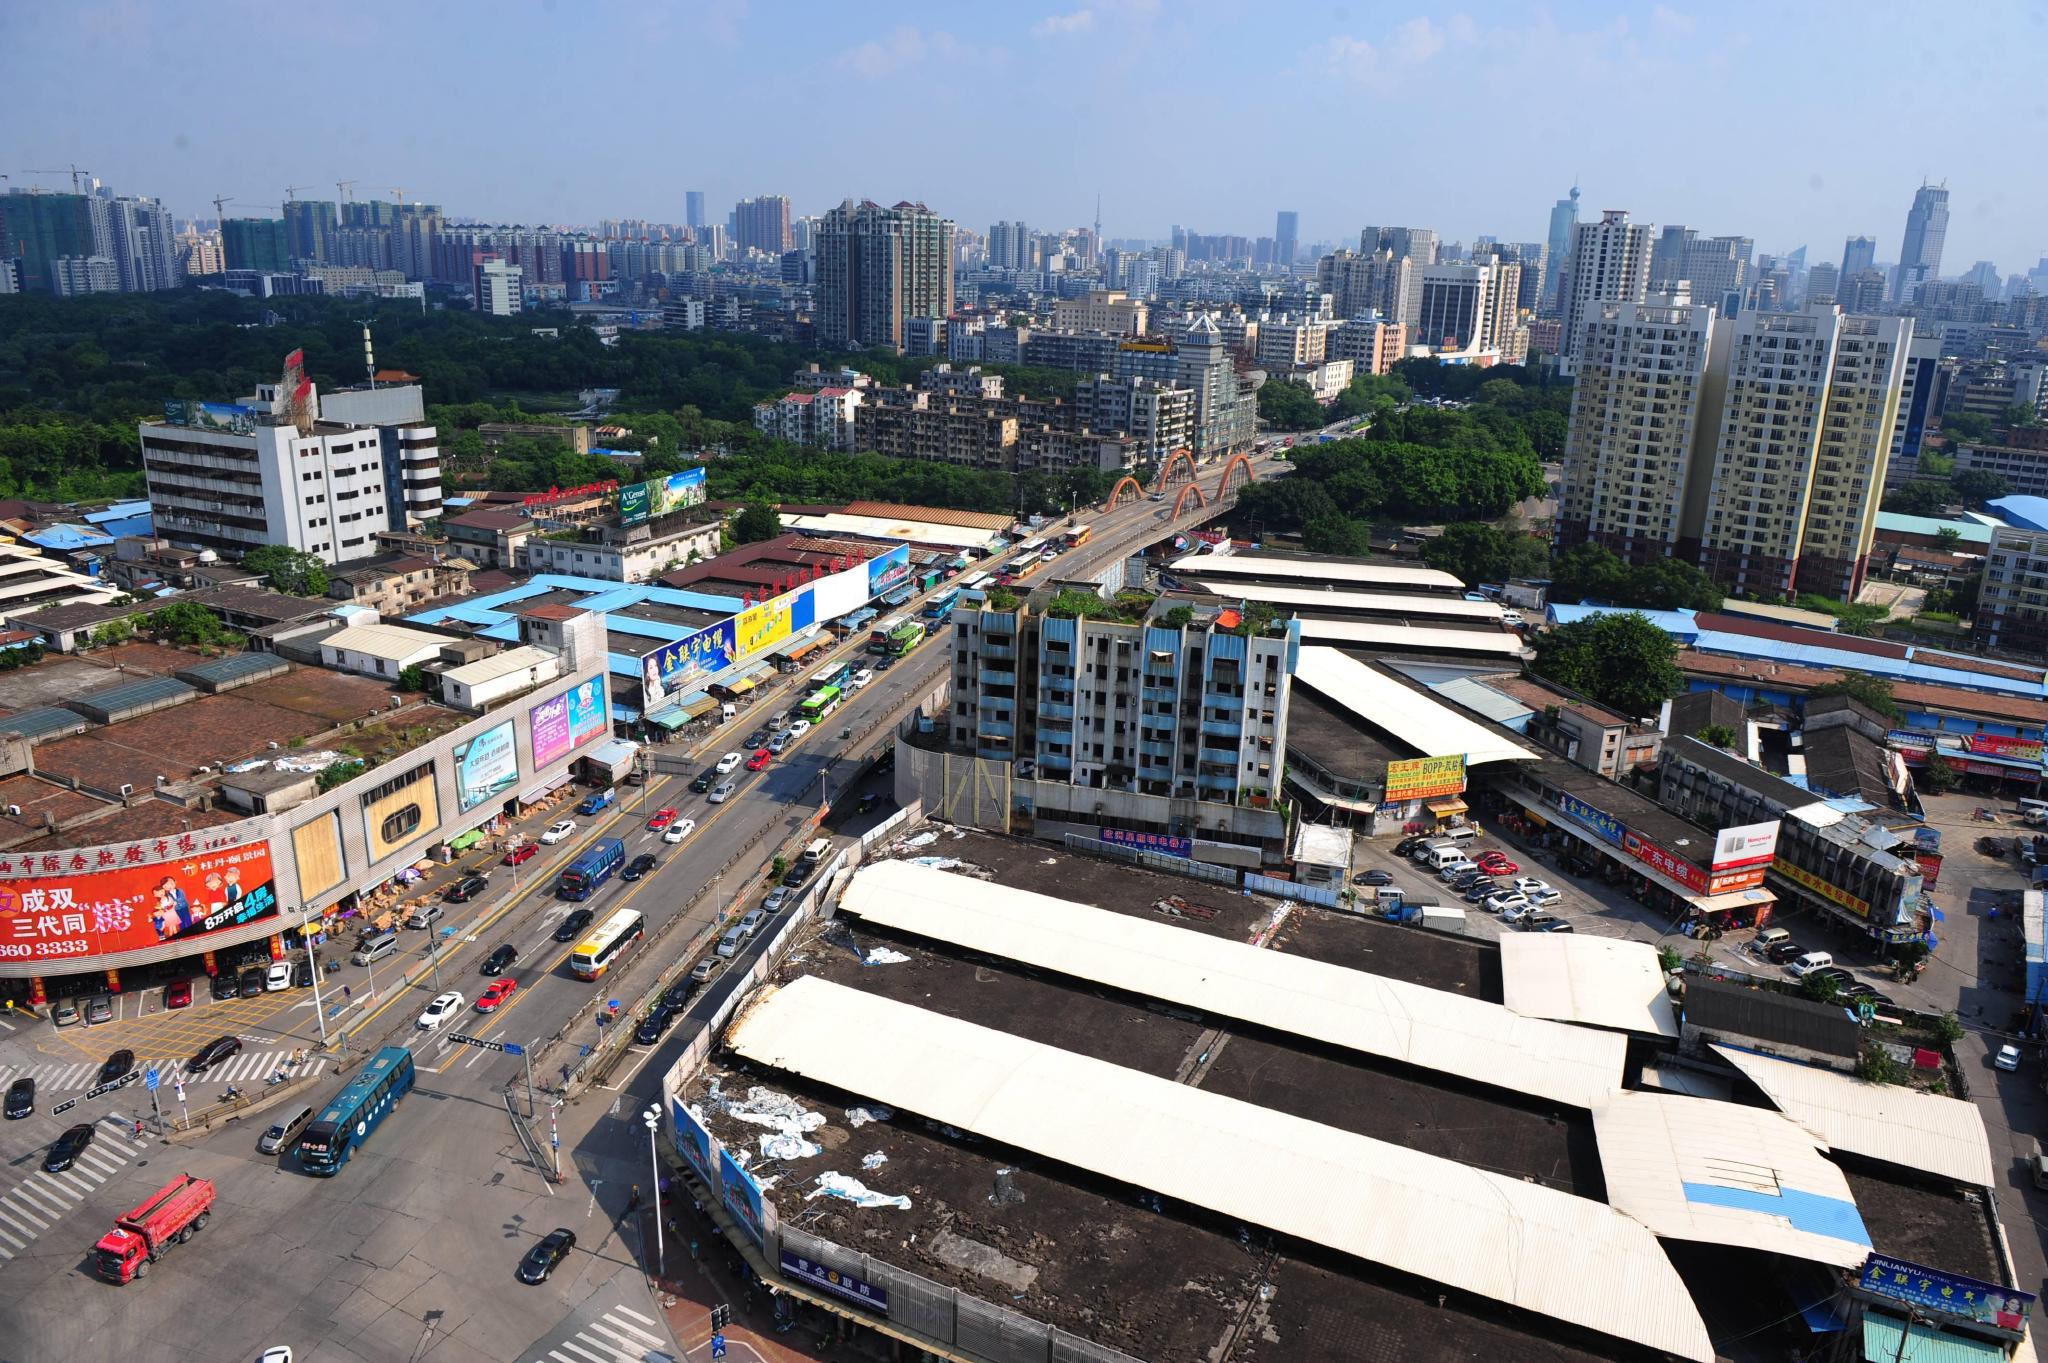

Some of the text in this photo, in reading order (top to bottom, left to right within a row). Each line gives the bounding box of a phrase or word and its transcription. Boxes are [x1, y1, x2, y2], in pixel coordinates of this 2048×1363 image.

[1748, 835, 1772, 843] Honeywell
[1640, 845, 1688, 880] 广东电缆
[36, 940, 89, 955] 3333
[1871, 1259, 1921, 1276] JINLIANYU
[799, 1259, 870, 1296] 警企联防
